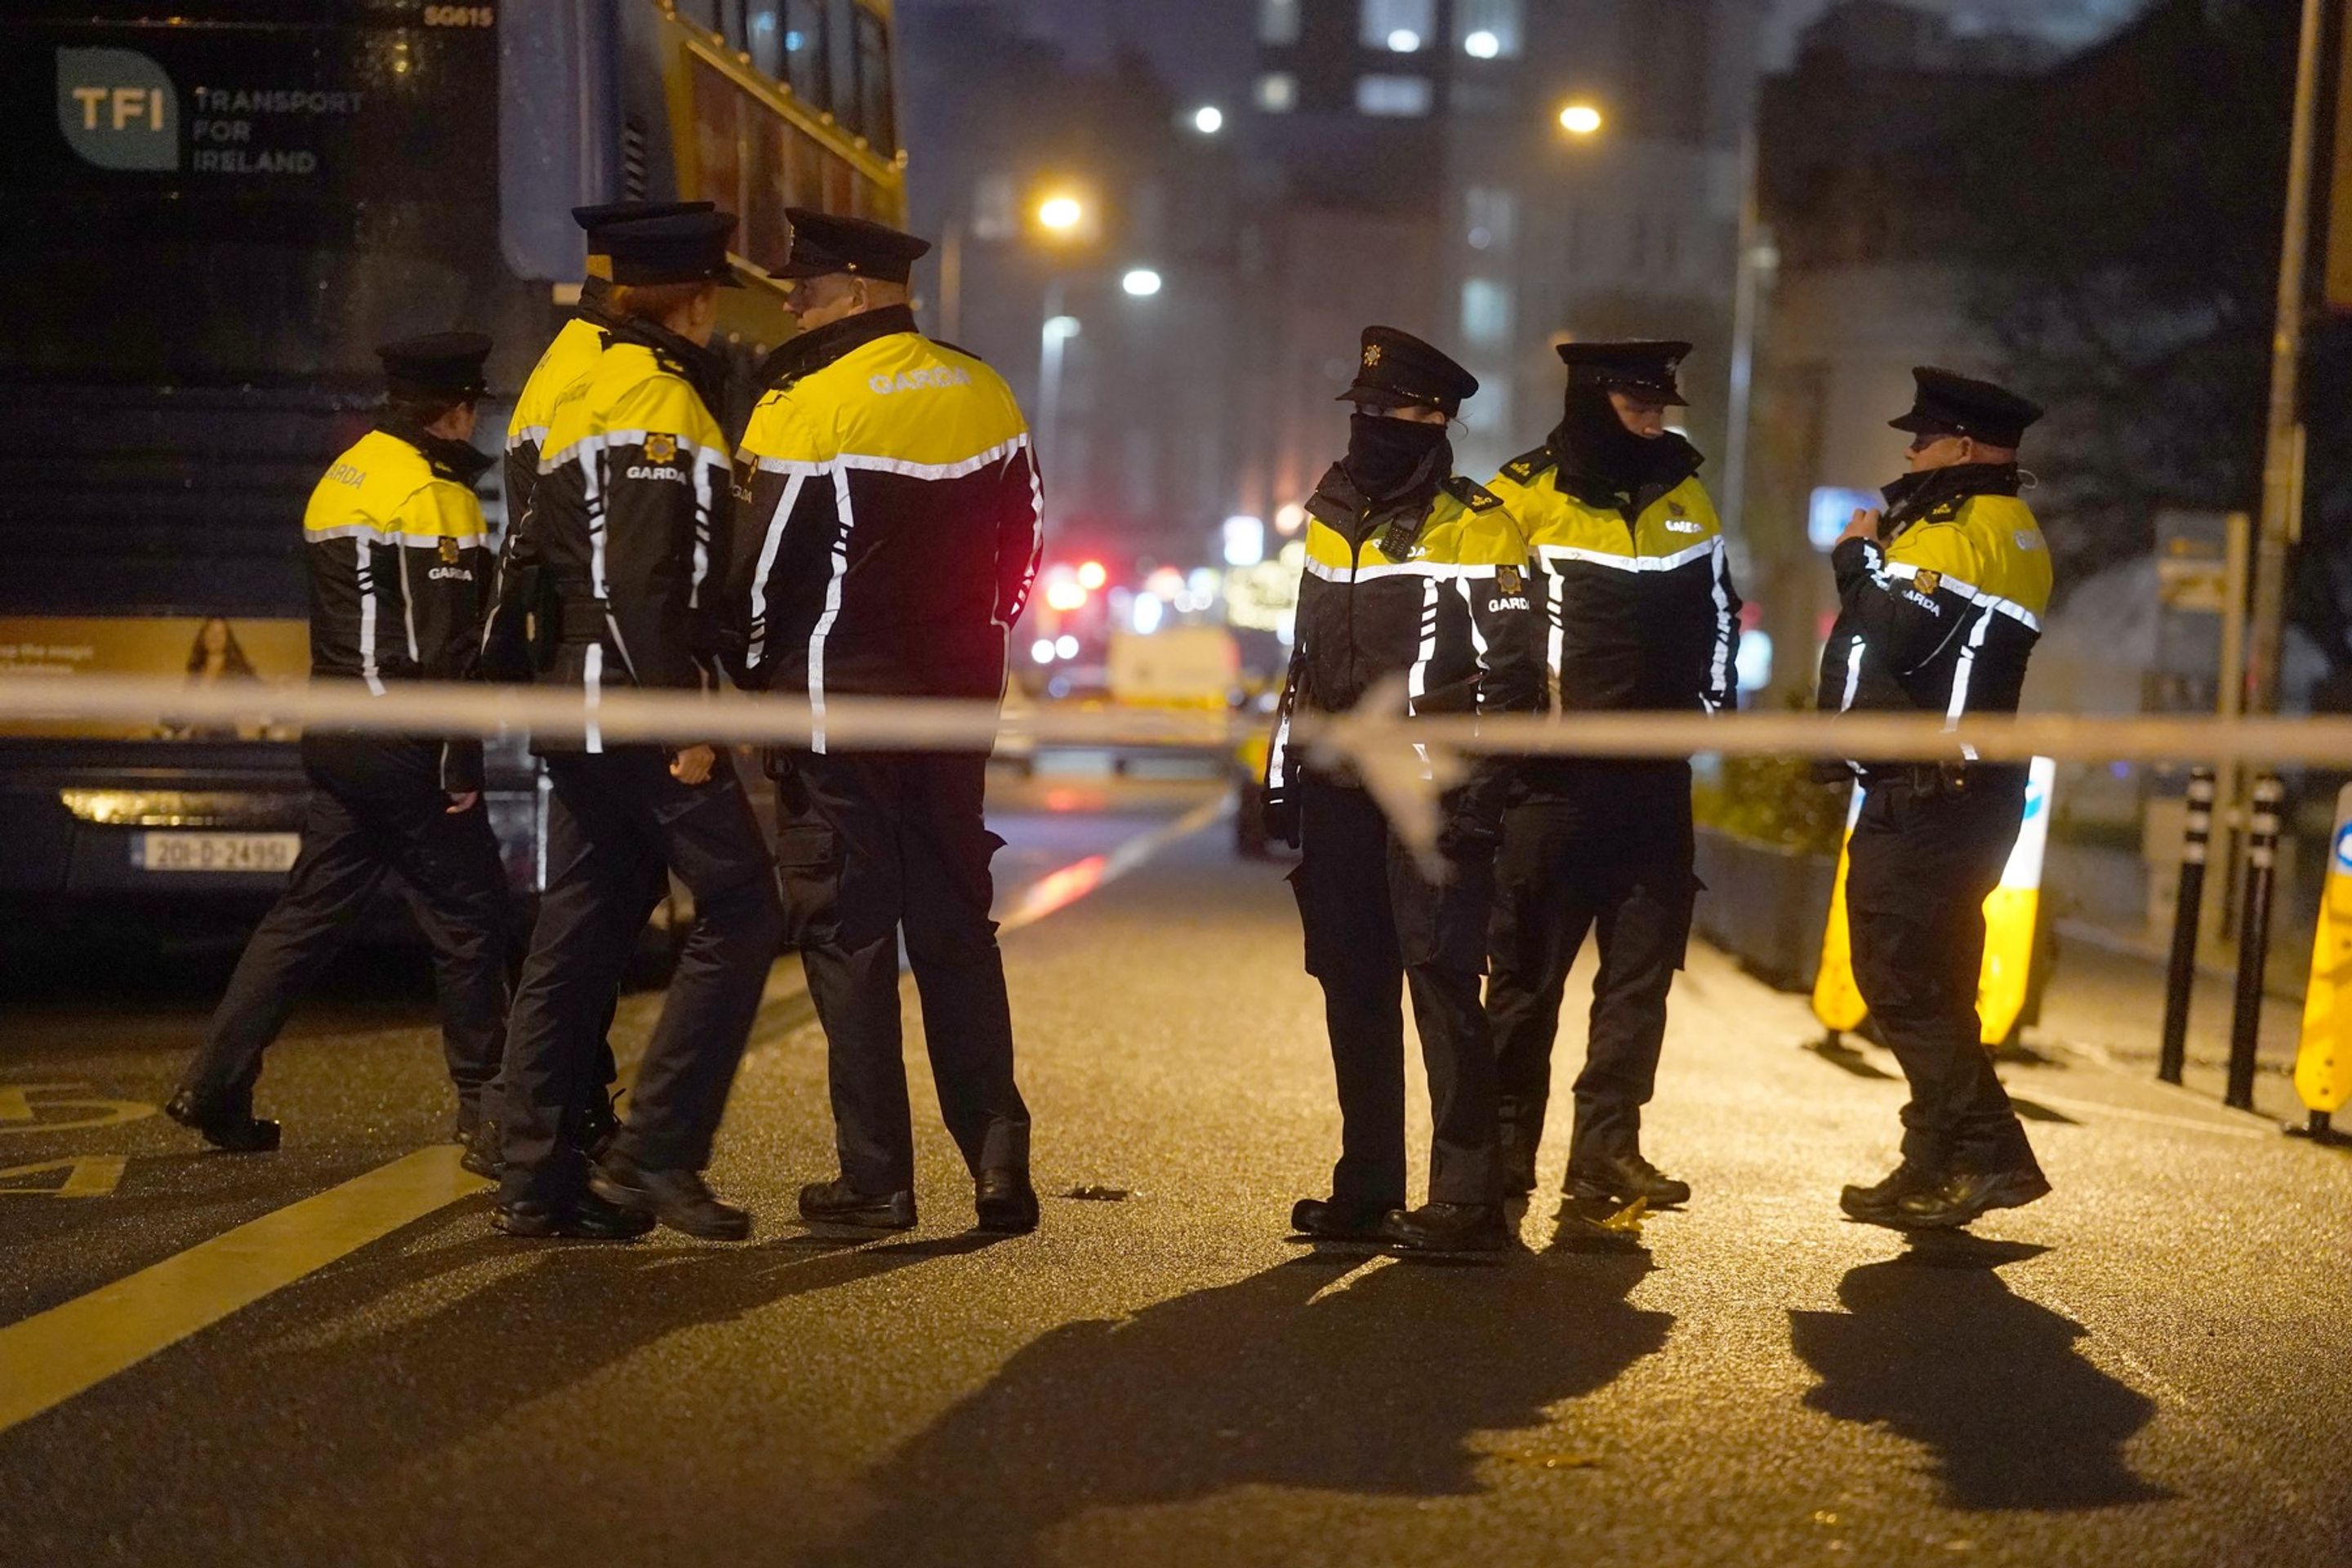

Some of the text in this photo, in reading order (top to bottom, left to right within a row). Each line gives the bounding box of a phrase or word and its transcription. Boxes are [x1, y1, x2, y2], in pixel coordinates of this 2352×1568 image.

[72, 87, 163, 131] TFI
[195, 87, 363, 113] TRANSPORT
[192, 120, 252, 142] FOR
[193, 149, 318, 174] IRELAND
[868, 366, 972, 395] GARDA
[325, 462, 367, 489] ARDA
[626, 466, 688, 486] GARDA
[428, 567, 474, 581] GARDA
[1488, 596, 1530, 612] GARD
